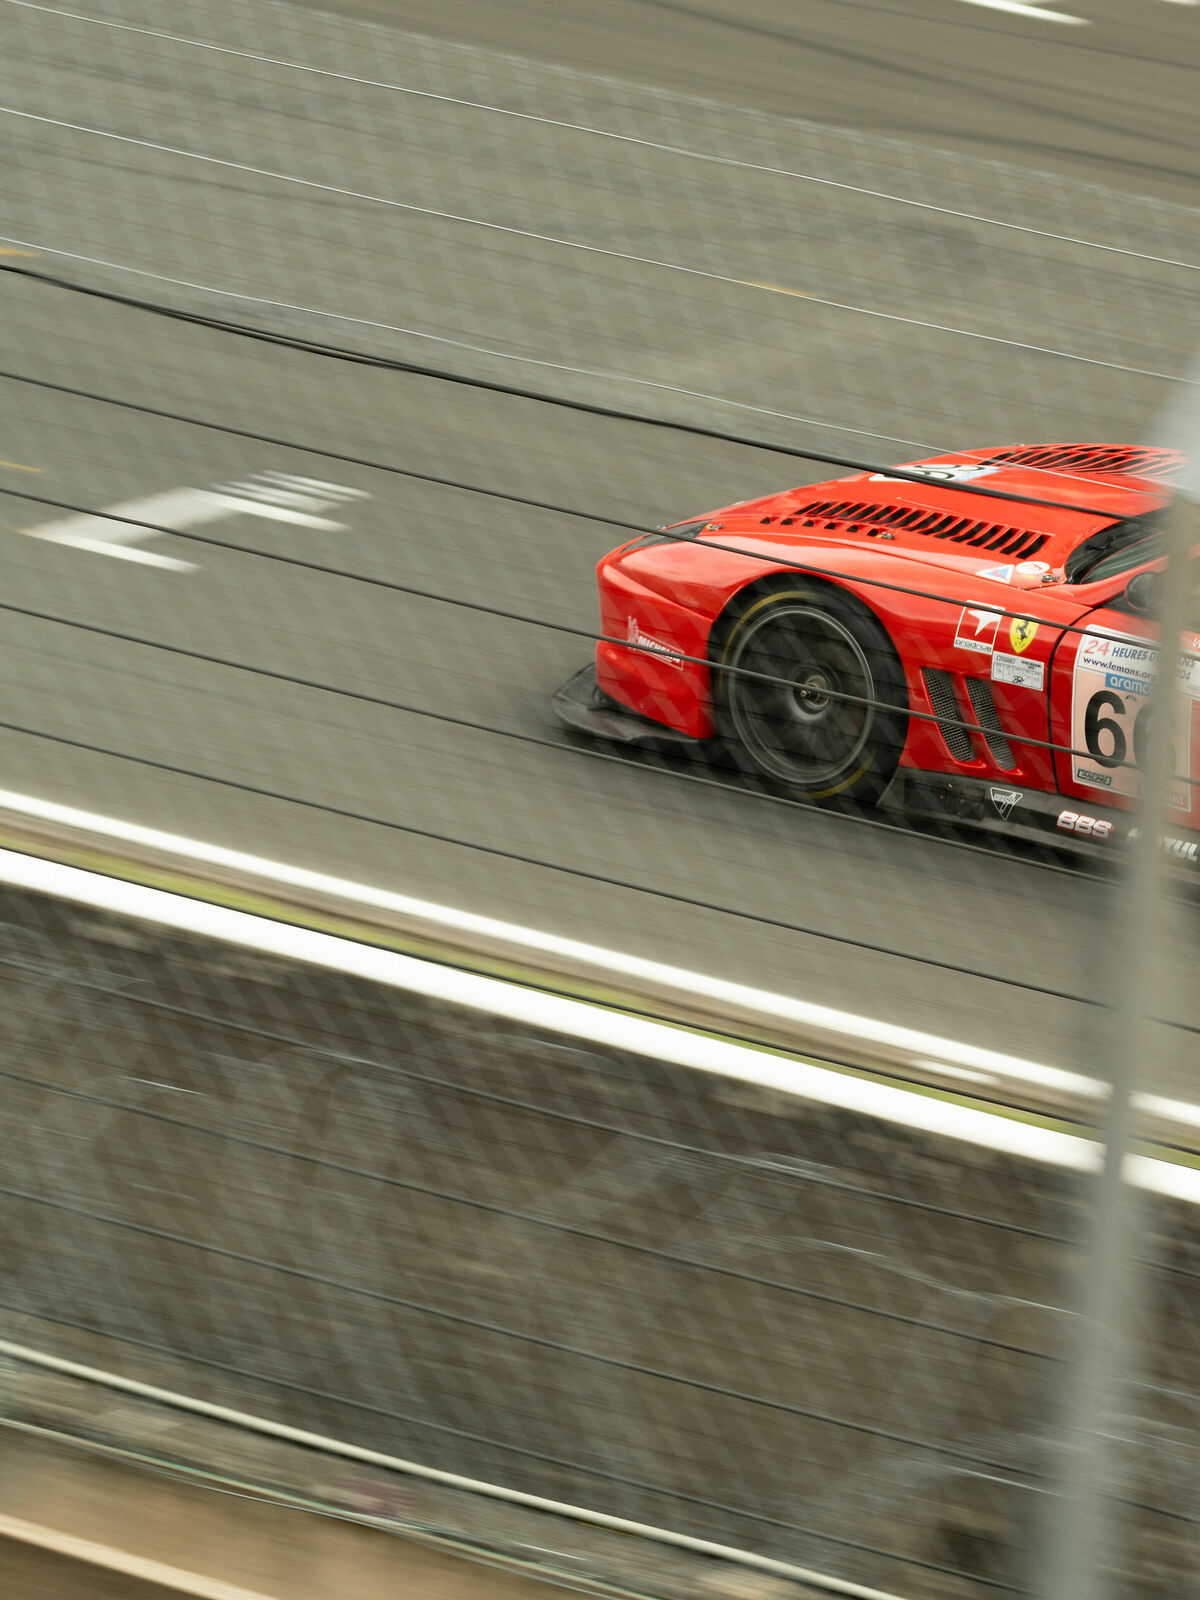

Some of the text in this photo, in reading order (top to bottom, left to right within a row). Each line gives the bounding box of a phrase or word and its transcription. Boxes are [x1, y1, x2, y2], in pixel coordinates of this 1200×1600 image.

[1084, 640, 1110, 656] 24
[1111, 646, 1147, 661] HEURES
[1056, 810, 1113, 839] BBS
[1126, 827, 1199, 862] MTUL
